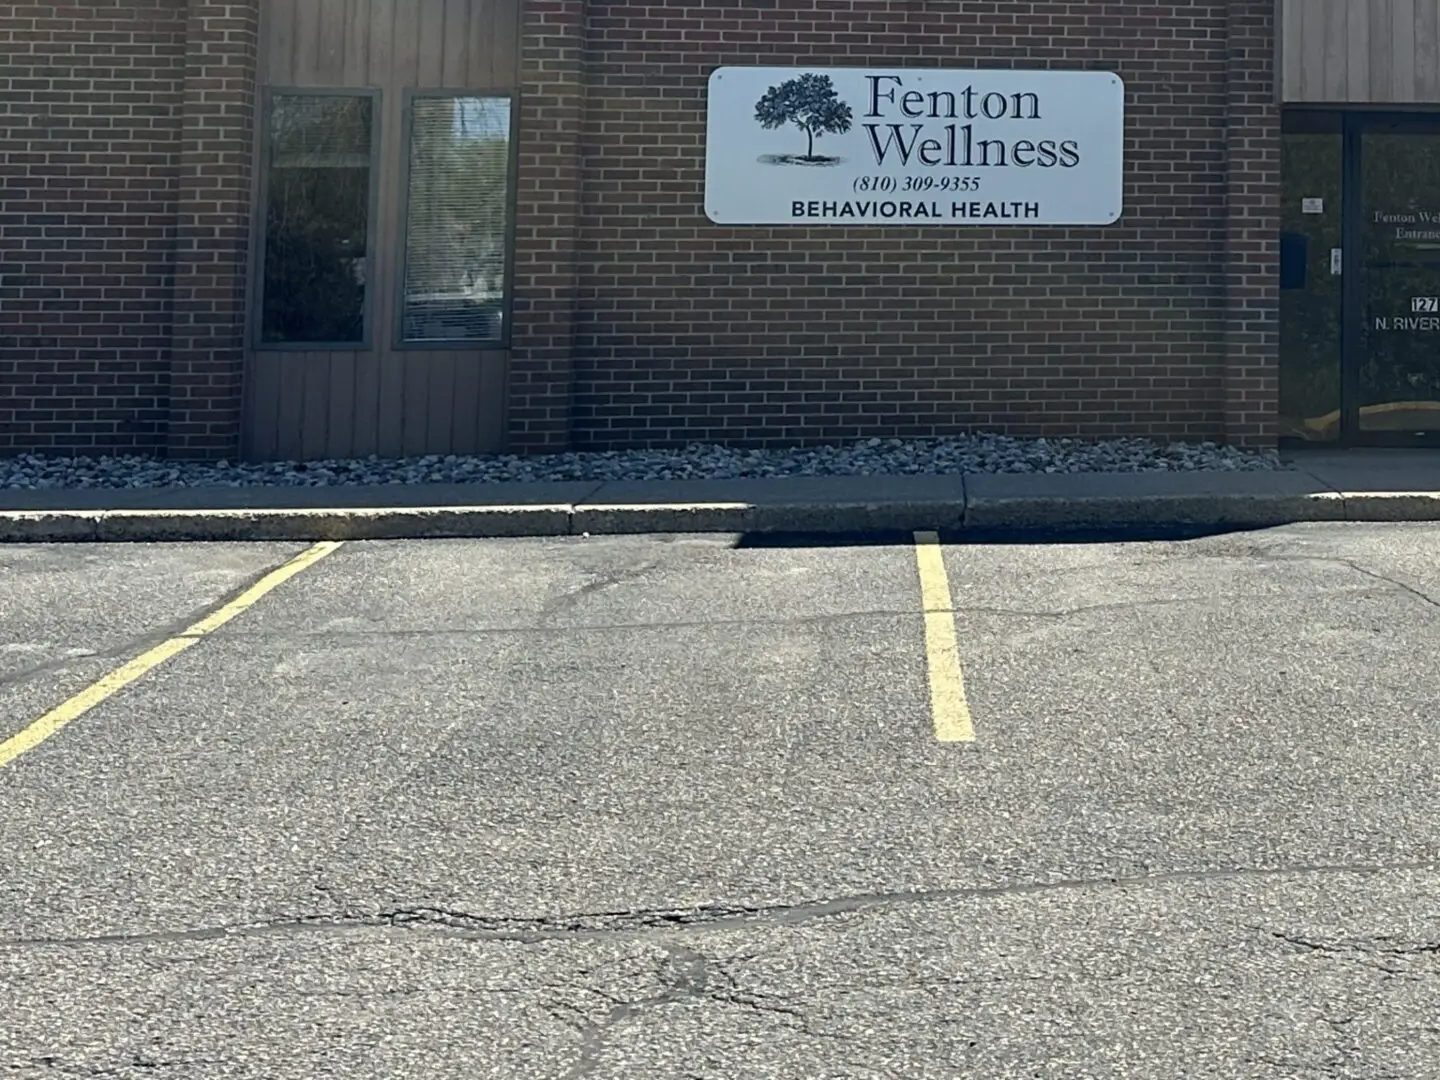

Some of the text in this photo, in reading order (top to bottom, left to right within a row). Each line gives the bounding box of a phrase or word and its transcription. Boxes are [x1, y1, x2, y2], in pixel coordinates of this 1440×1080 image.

[863, 75, 1042, 120] Fenton
[862, 123, 1080, 168] Wellness
[853, 176, 981, 194] (810) 309-9355
[791, 200, 1039, 218] BEHAVIORAL HEALTH
[1374, 210, 1416, 224] Fenton
[1412, 297, 1437, 311] 127
[1375, 317, 1390, 330] N.
[1393, 317, 1440, 330] RIVER
